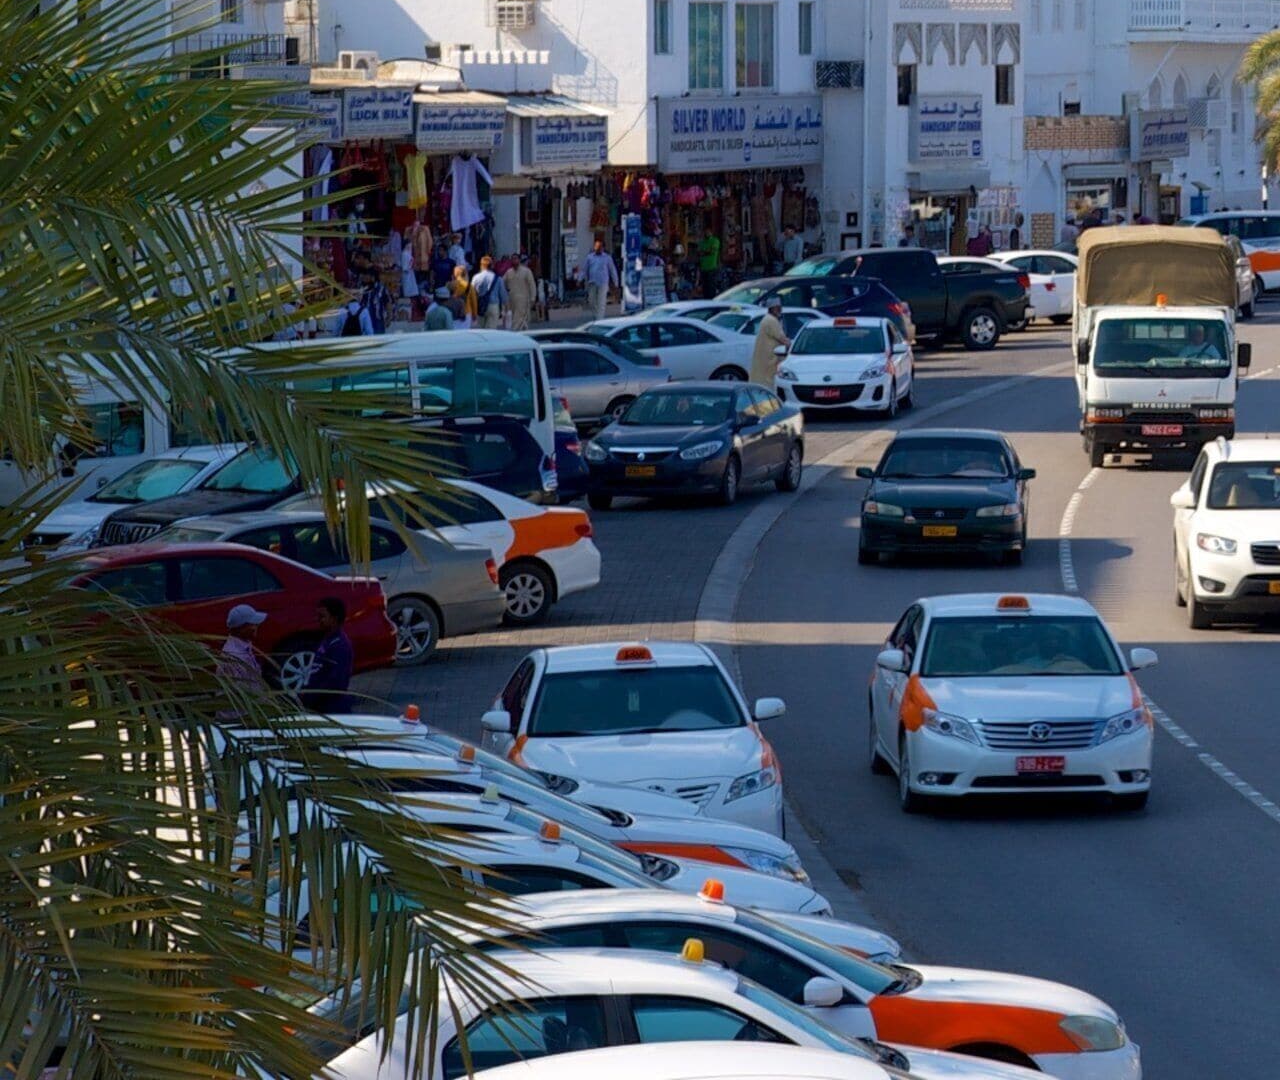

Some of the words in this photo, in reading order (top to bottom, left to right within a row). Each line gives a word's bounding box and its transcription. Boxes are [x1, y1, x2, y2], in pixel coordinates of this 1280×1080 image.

[350, 108, 378, 121] LUCK
[382, 107, 409, 120] SILK
[672, 108, 709, 134] SILVER
[711, 107, 746, 133] WORLD
